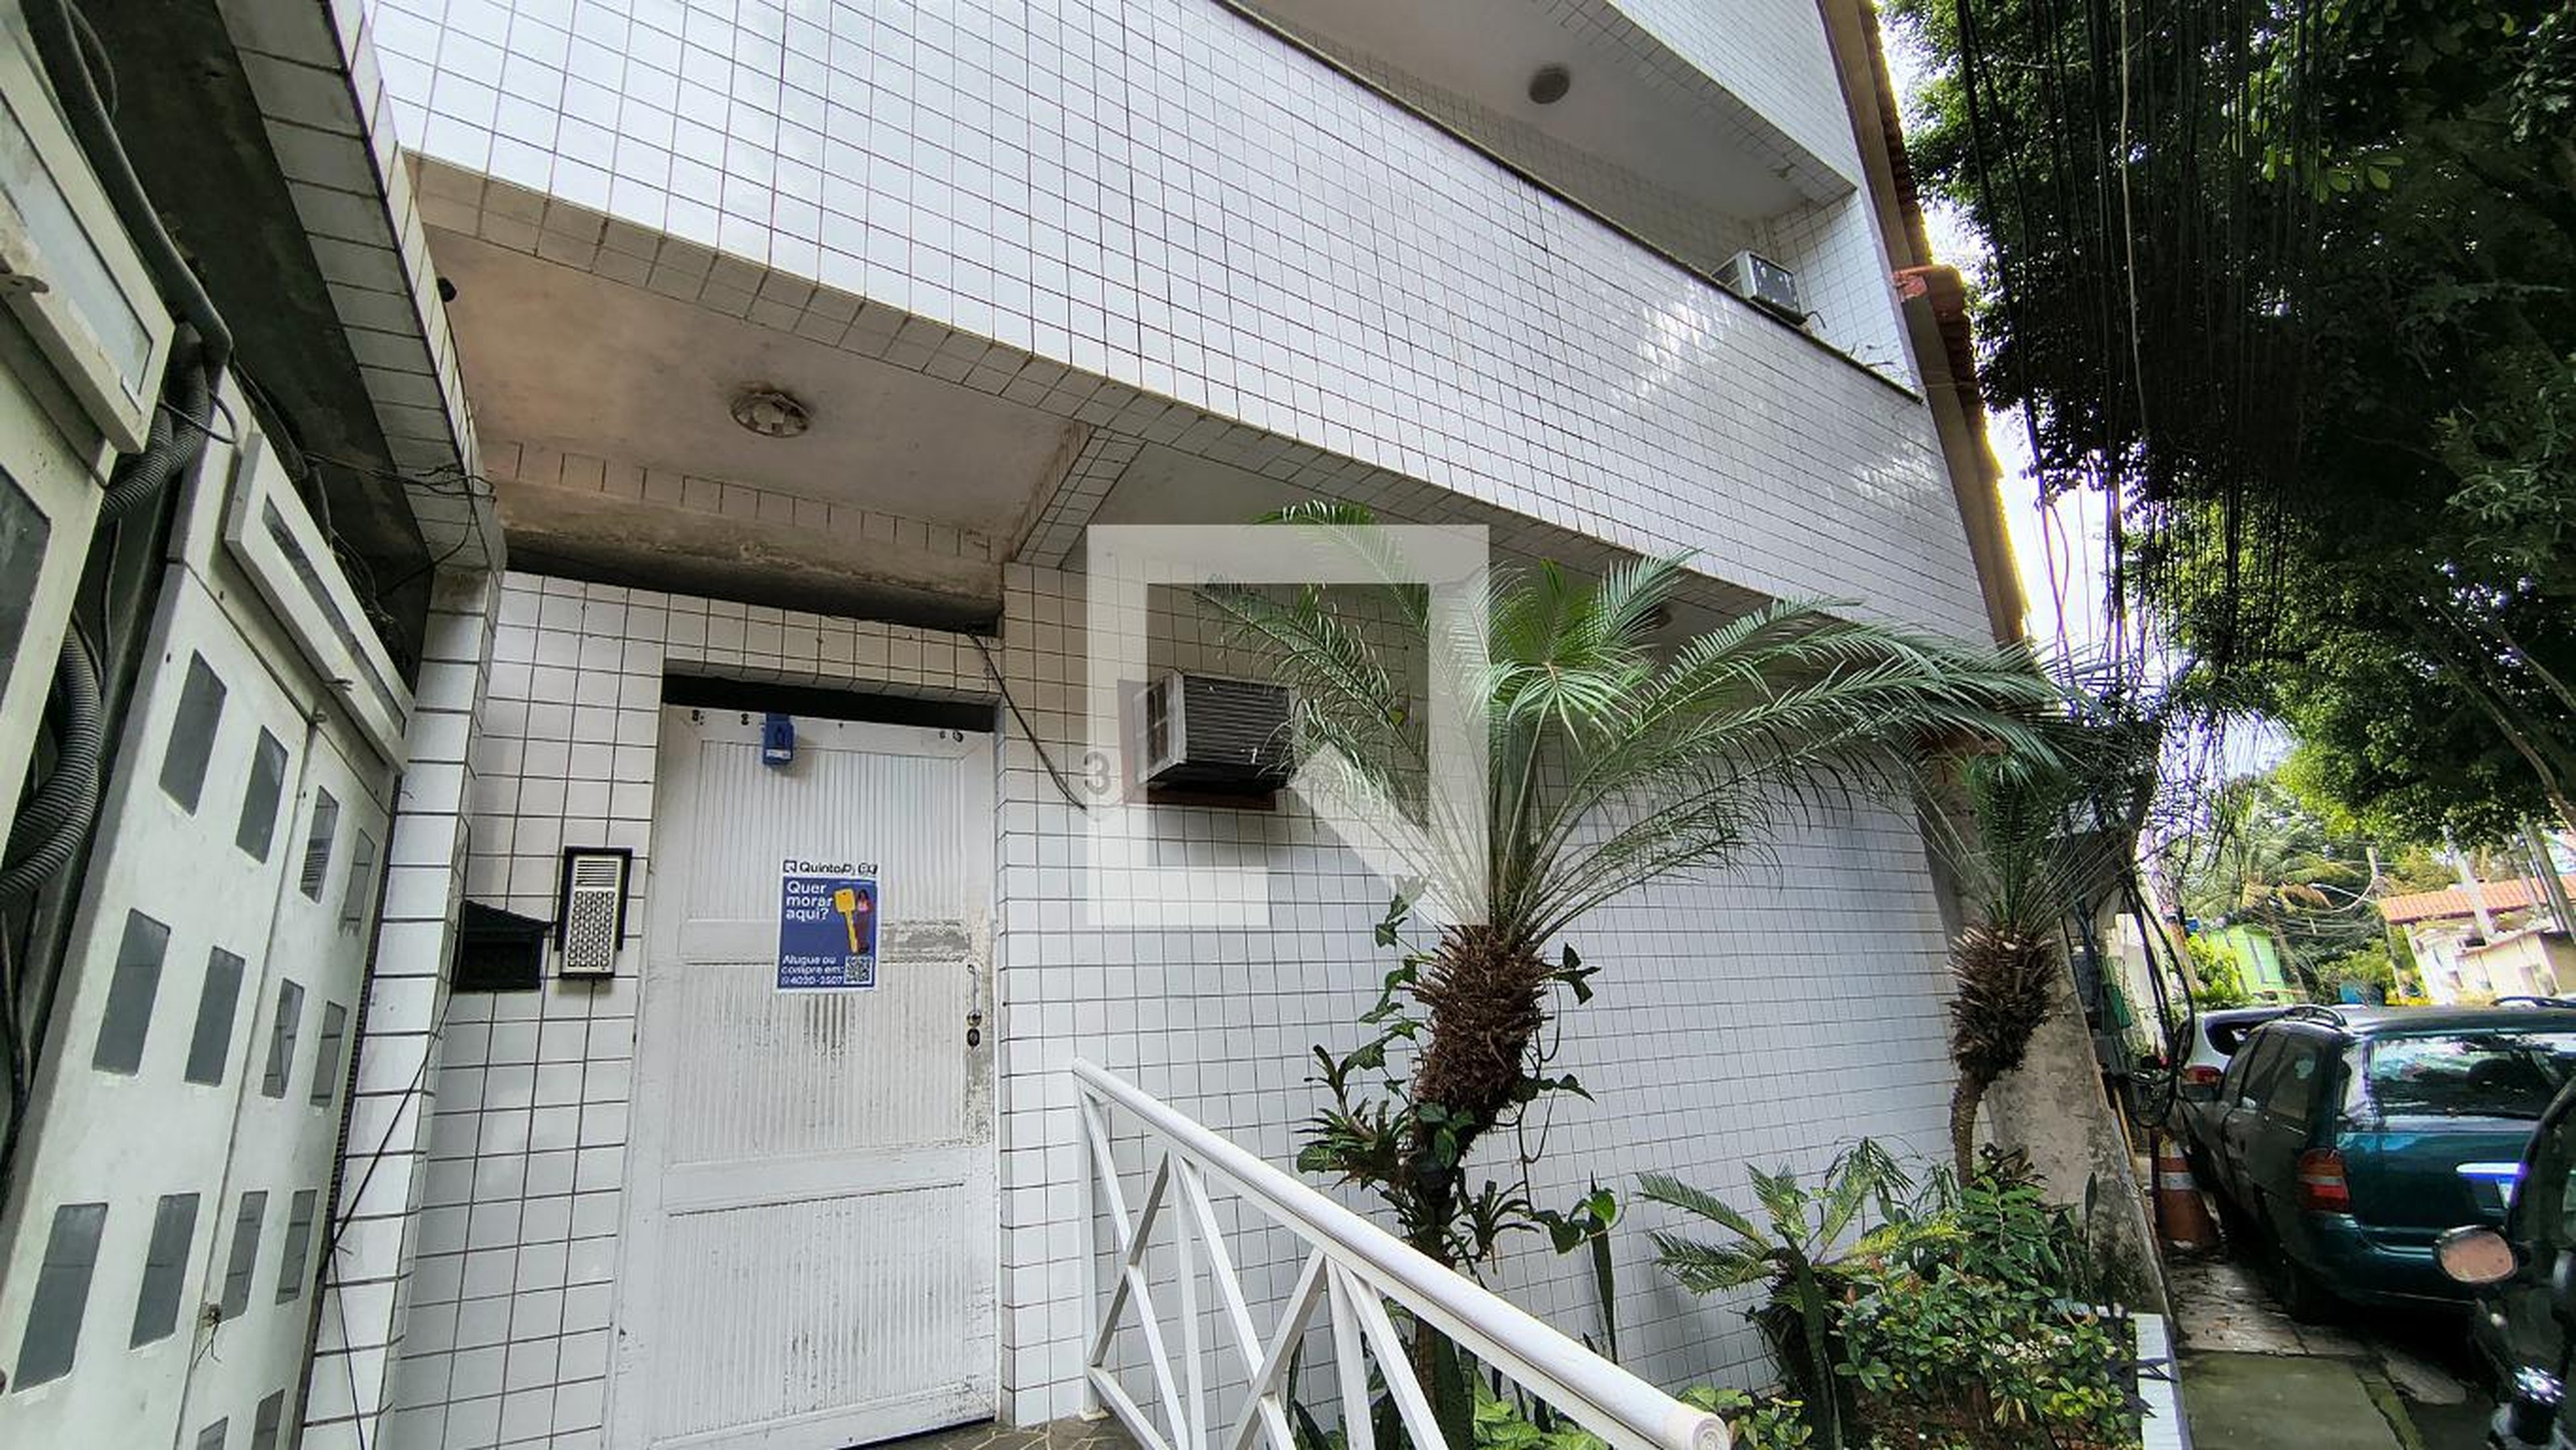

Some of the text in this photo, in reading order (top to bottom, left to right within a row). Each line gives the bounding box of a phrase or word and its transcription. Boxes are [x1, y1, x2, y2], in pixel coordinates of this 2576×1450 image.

[1084, 751, 1110, 795] 3
[787, 880, 826, 894] Quer
[786, 896, 834, 907] morar
[786, 907, 829, 922] aqui?
